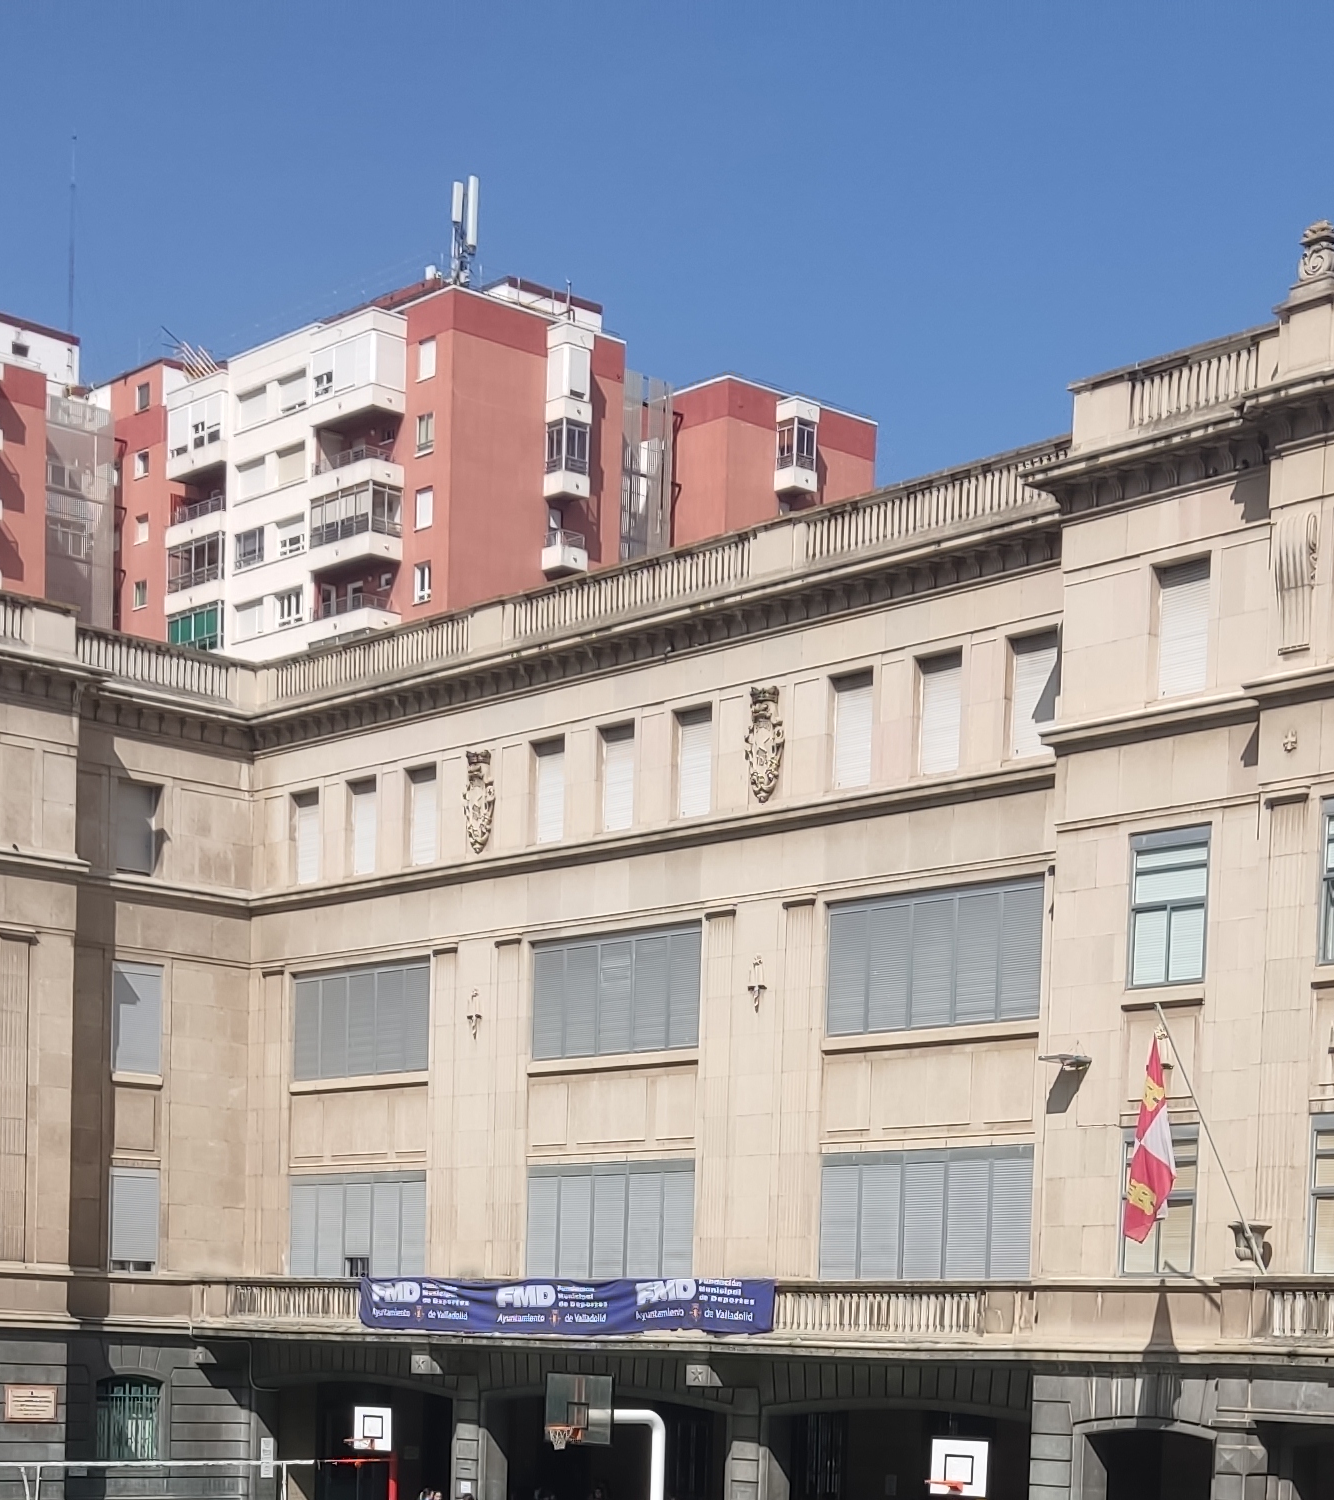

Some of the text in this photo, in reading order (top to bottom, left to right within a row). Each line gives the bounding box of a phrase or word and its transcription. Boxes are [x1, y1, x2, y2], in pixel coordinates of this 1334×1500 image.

[496, 1284, 556, 1308] FMD
[636, 1279, 696, 1305] FMD
[574, 1313, 607, 1323] Valladolid
[715, 1309, 753, 1321] Valladolid
